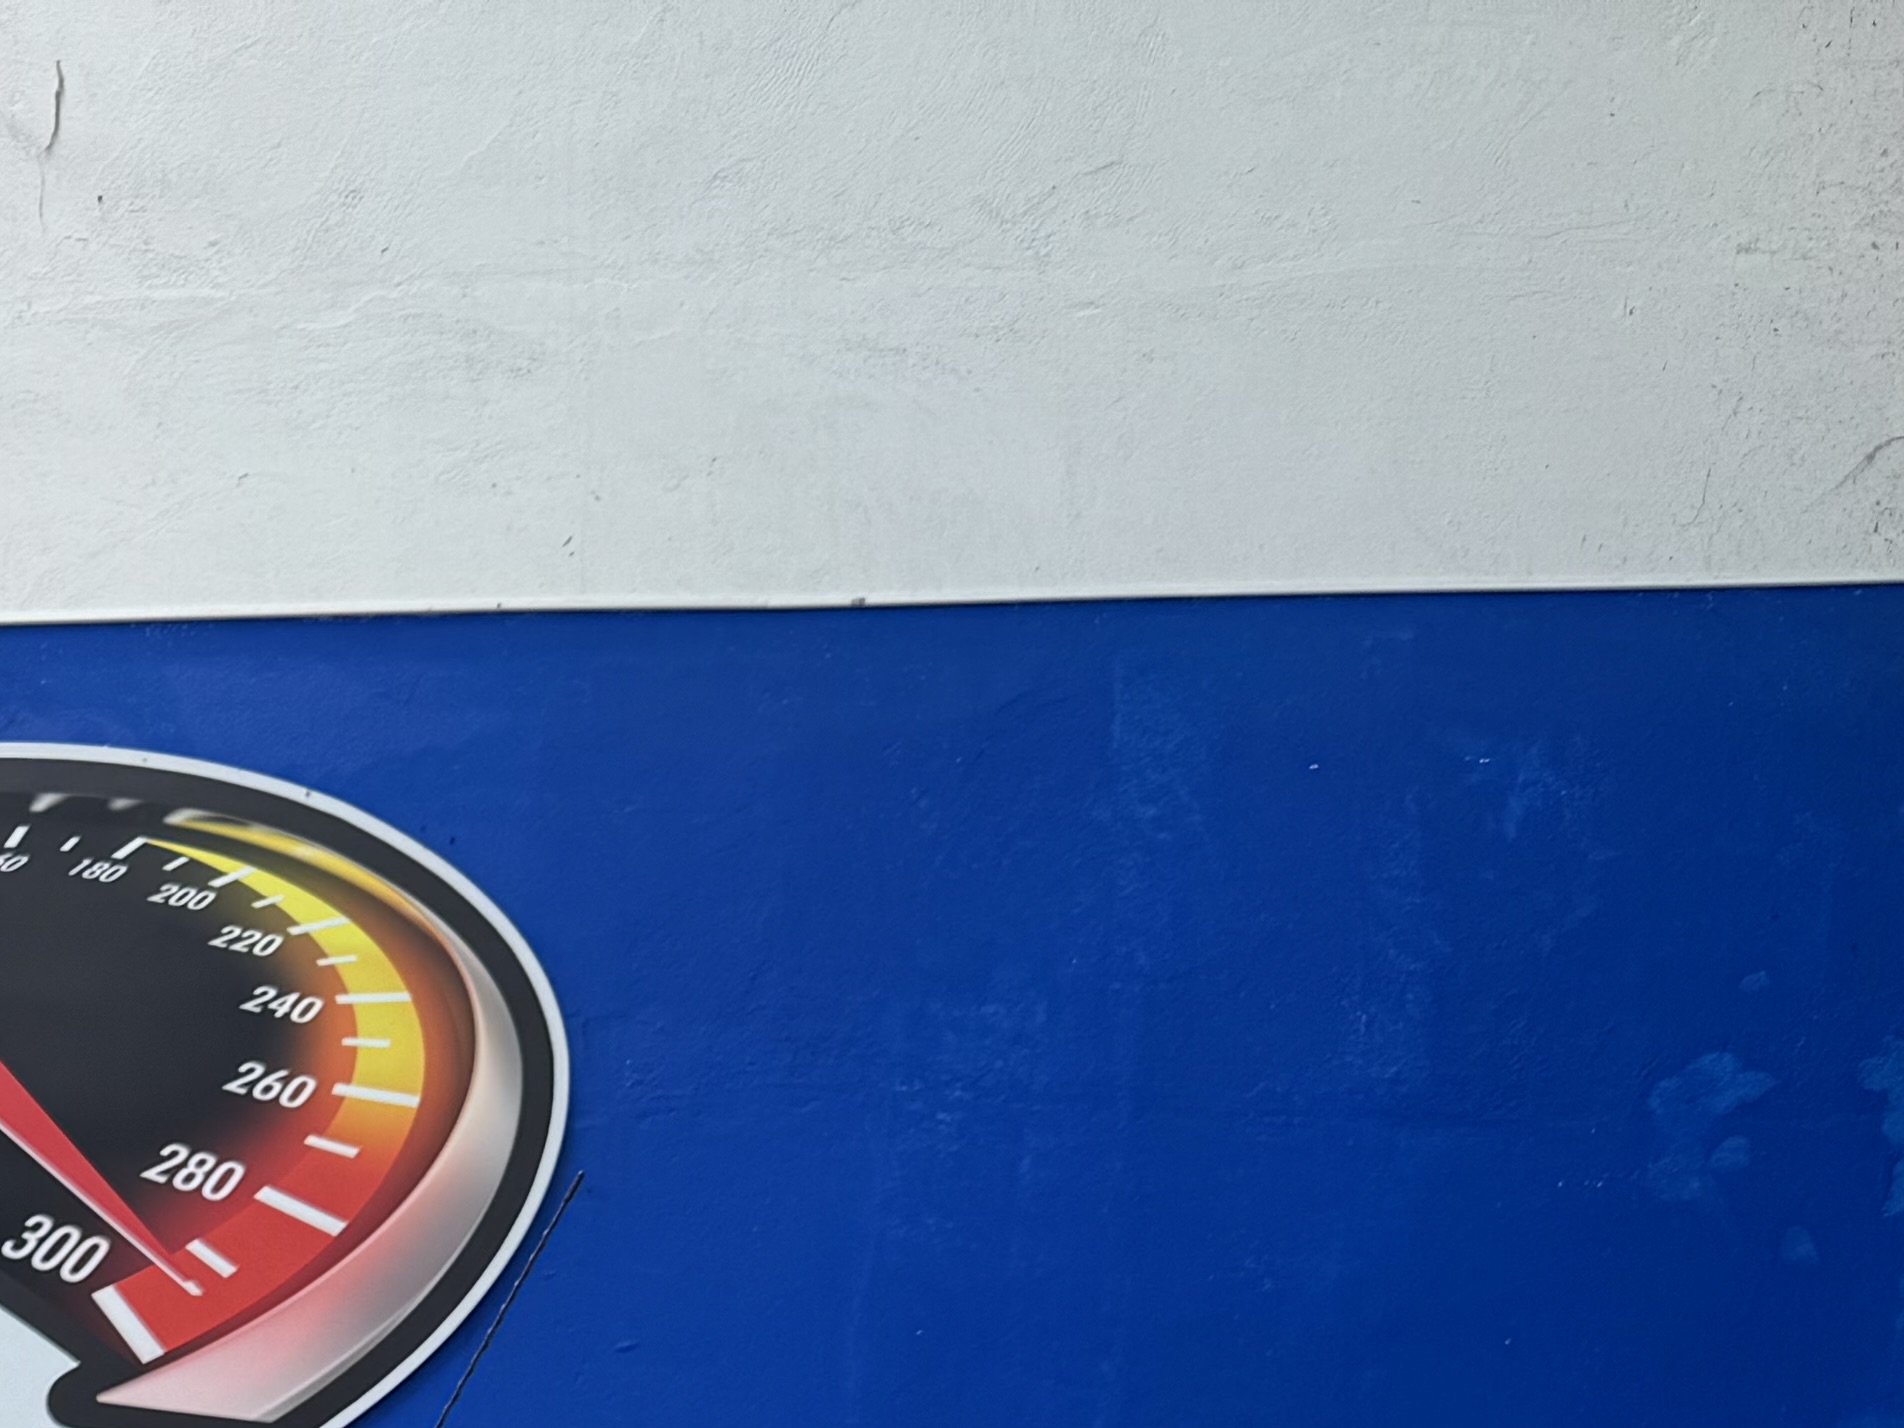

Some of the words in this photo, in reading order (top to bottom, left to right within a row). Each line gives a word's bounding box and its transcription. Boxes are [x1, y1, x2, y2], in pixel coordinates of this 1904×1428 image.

[68, 858, 128, 883] 180
[147, 883, 217, 910] 200
[208, 925, 284, 957] 220
[239, 985, 324, 1024] 240
[222, 1061, 317, 1108] 260
[140, 1143, 246, 1201] 280
[1, 1214, 111, 1283] 300
